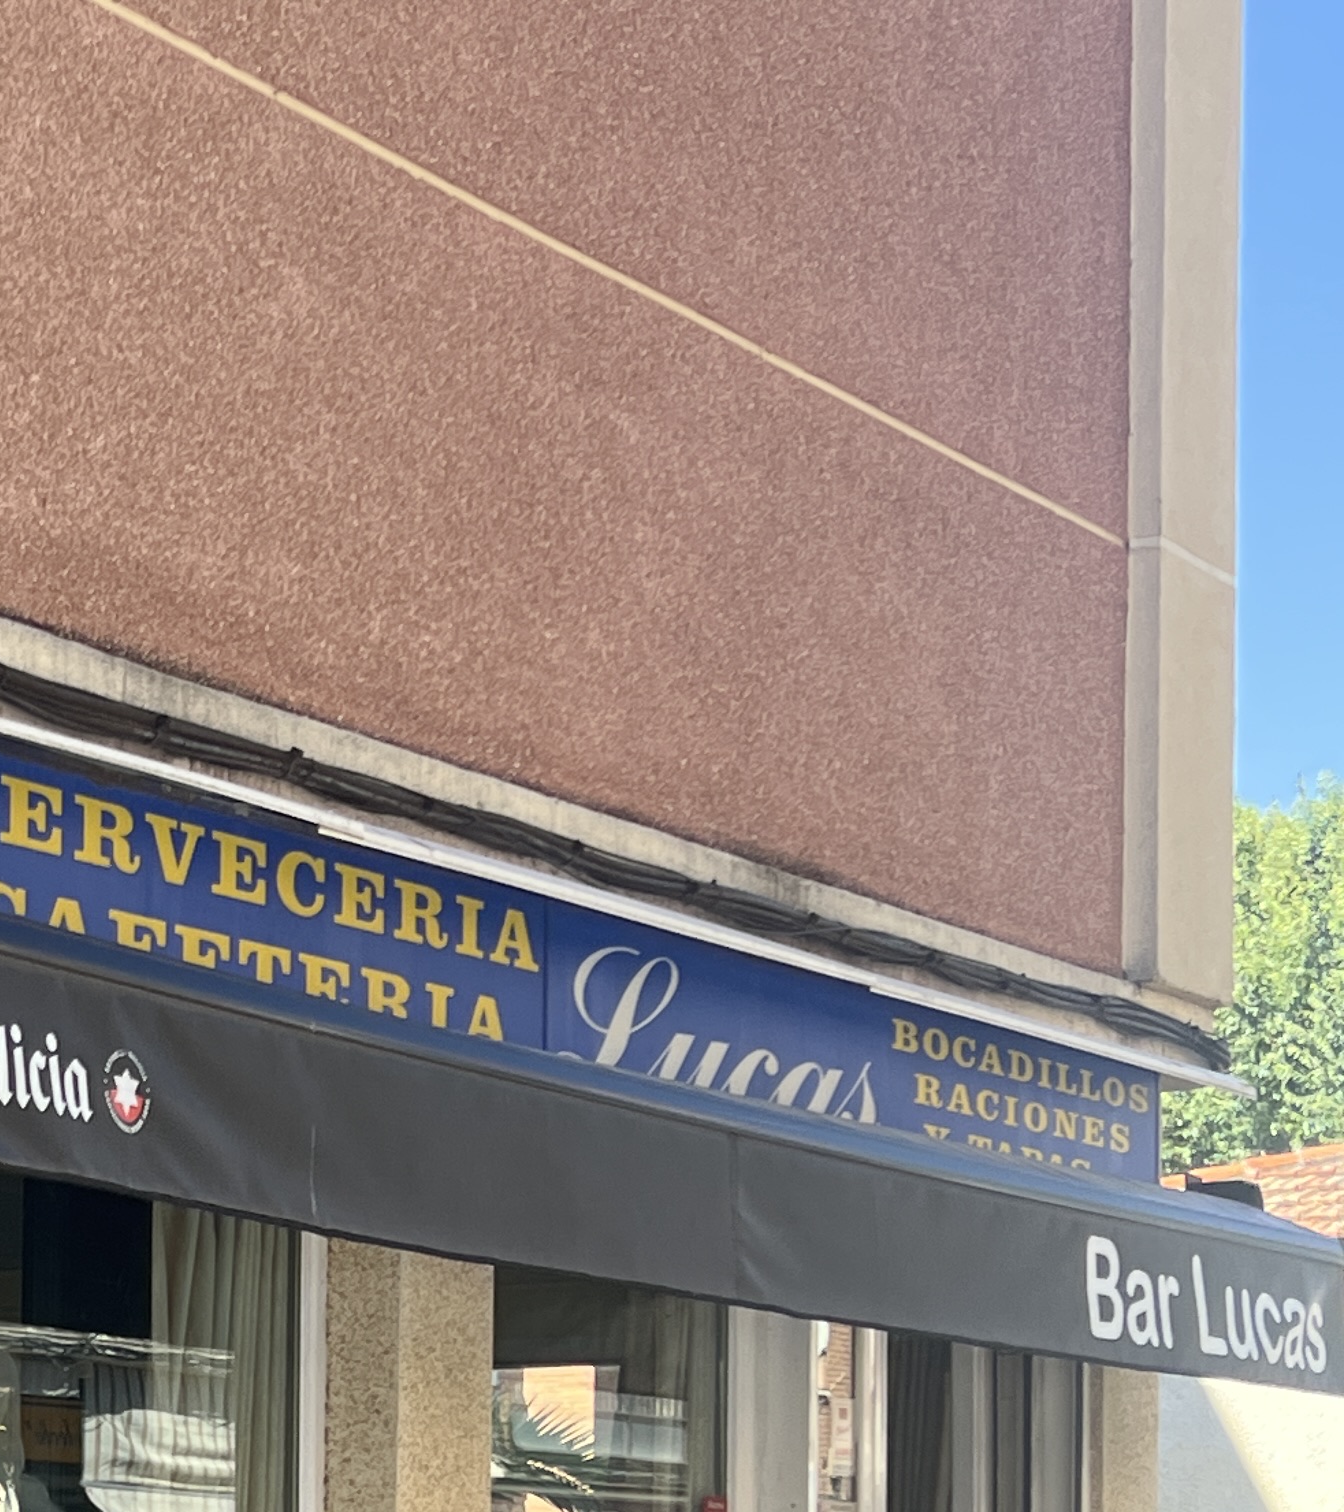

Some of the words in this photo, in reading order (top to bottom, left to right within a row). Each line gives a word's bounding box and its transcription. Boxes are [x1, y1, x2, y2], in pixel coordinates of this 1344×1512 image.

[891, 1018, 1149, 1113] BOCADILLOS
[913, 1073, 1130, 1154] RACIONES
[1086, 1235, 1180, 1350] Bar
[1191, 1254, 1327, 1374] Lucas
